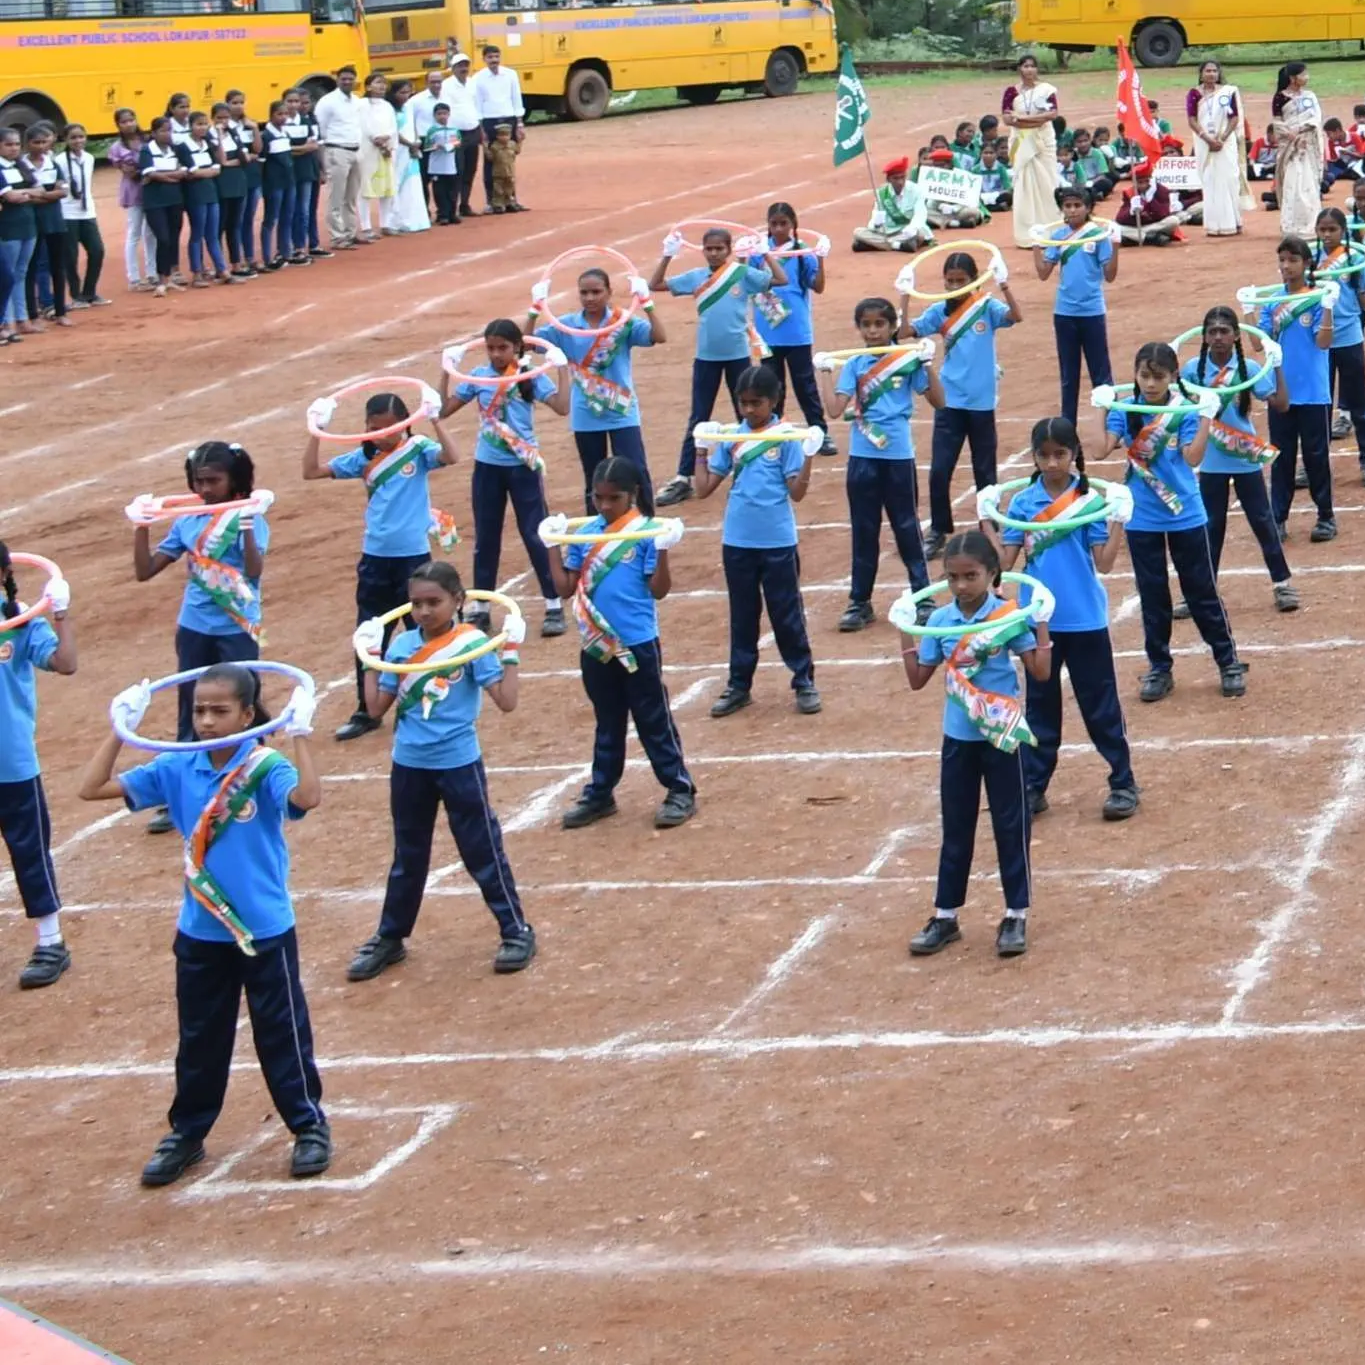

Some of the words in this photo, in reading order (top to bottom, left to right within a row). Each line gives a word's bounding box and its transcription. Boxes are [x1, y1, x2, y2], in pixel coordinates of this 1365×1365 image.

[18, 34, 78, 47] EXCELLENT
[81, 33, 117, 45] PUBLIC
[121, 31, 162, 44] SCHOOL
[925, 168, 977, 188] ARMY
[1155, 175, 1189, 184] HOUSE
[927, 185, 967, 199] HOUSE
